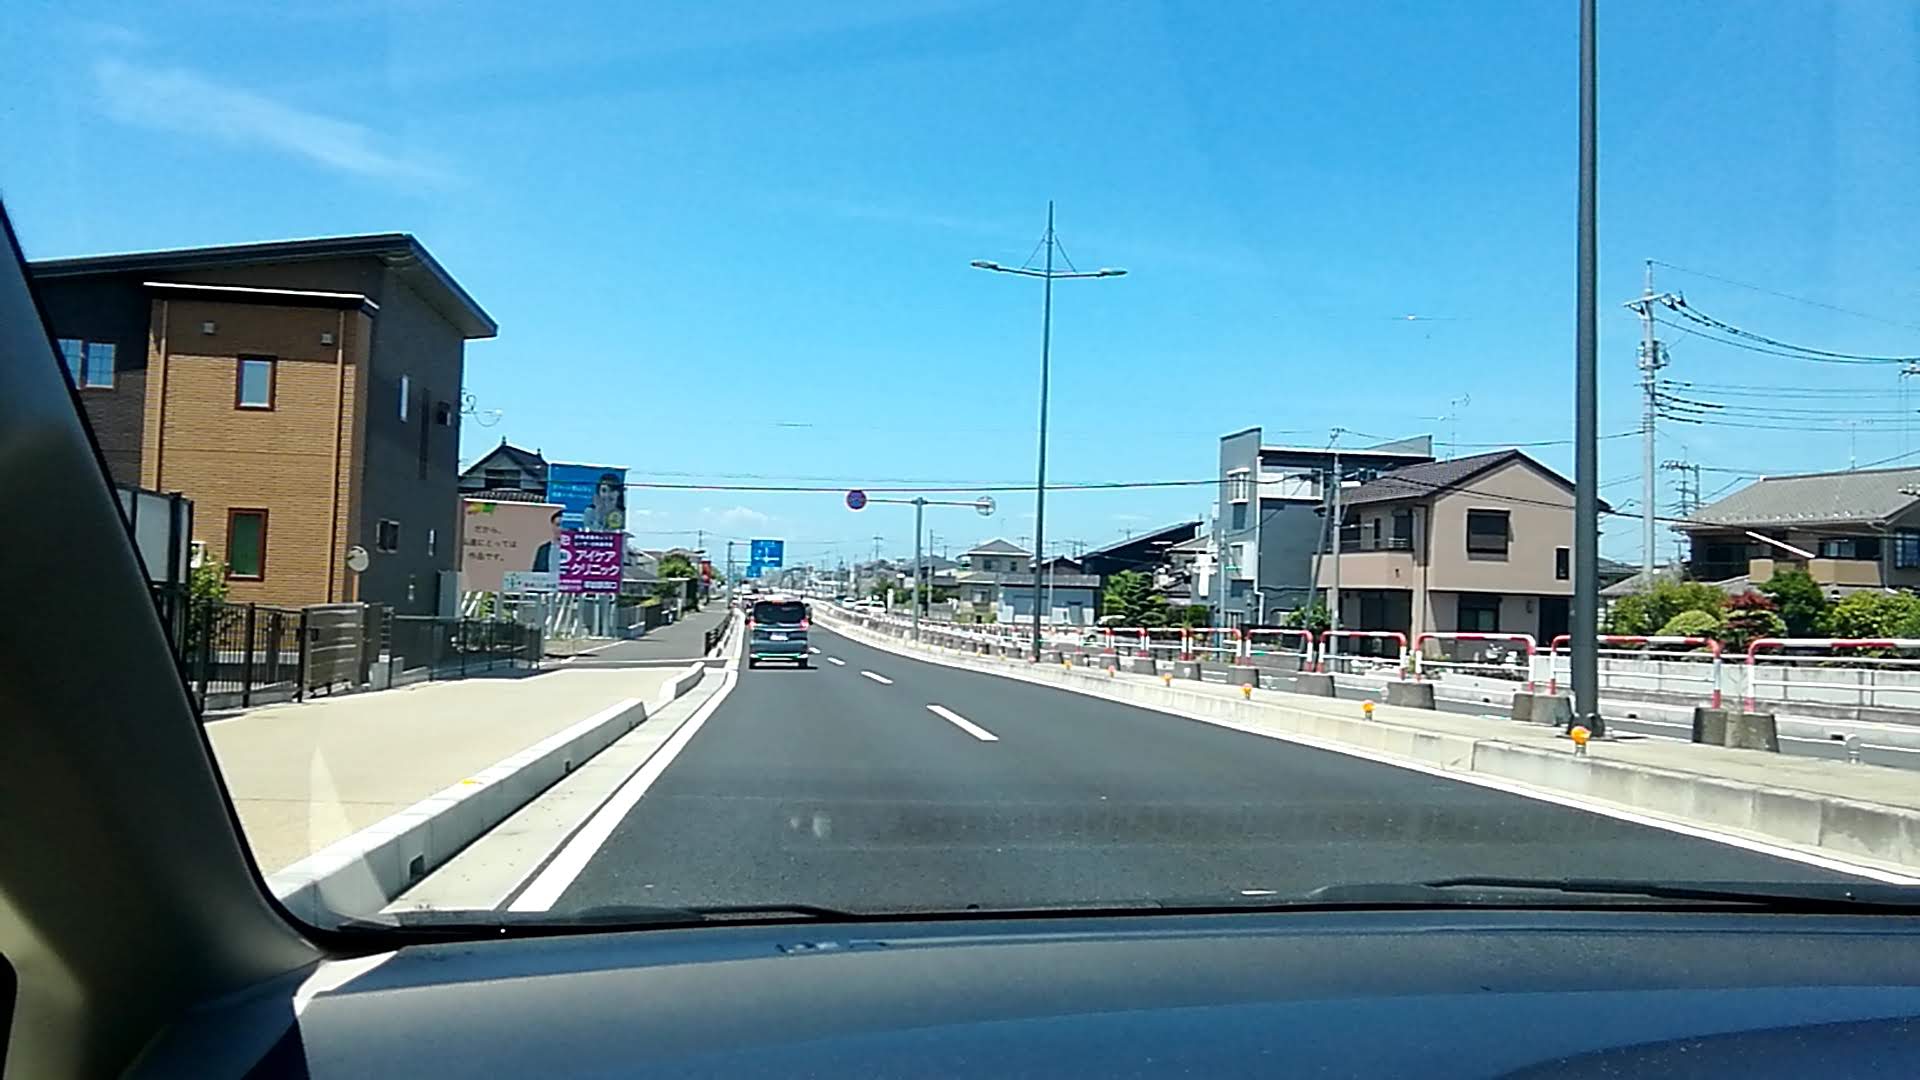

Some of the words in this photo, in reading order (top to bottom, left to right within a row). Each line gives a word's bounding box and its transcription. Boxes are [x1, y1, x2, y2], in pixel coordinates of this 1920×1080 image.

[575, 550, 616, 562] アイケア
[571, 563, 620, 576] クリニック
